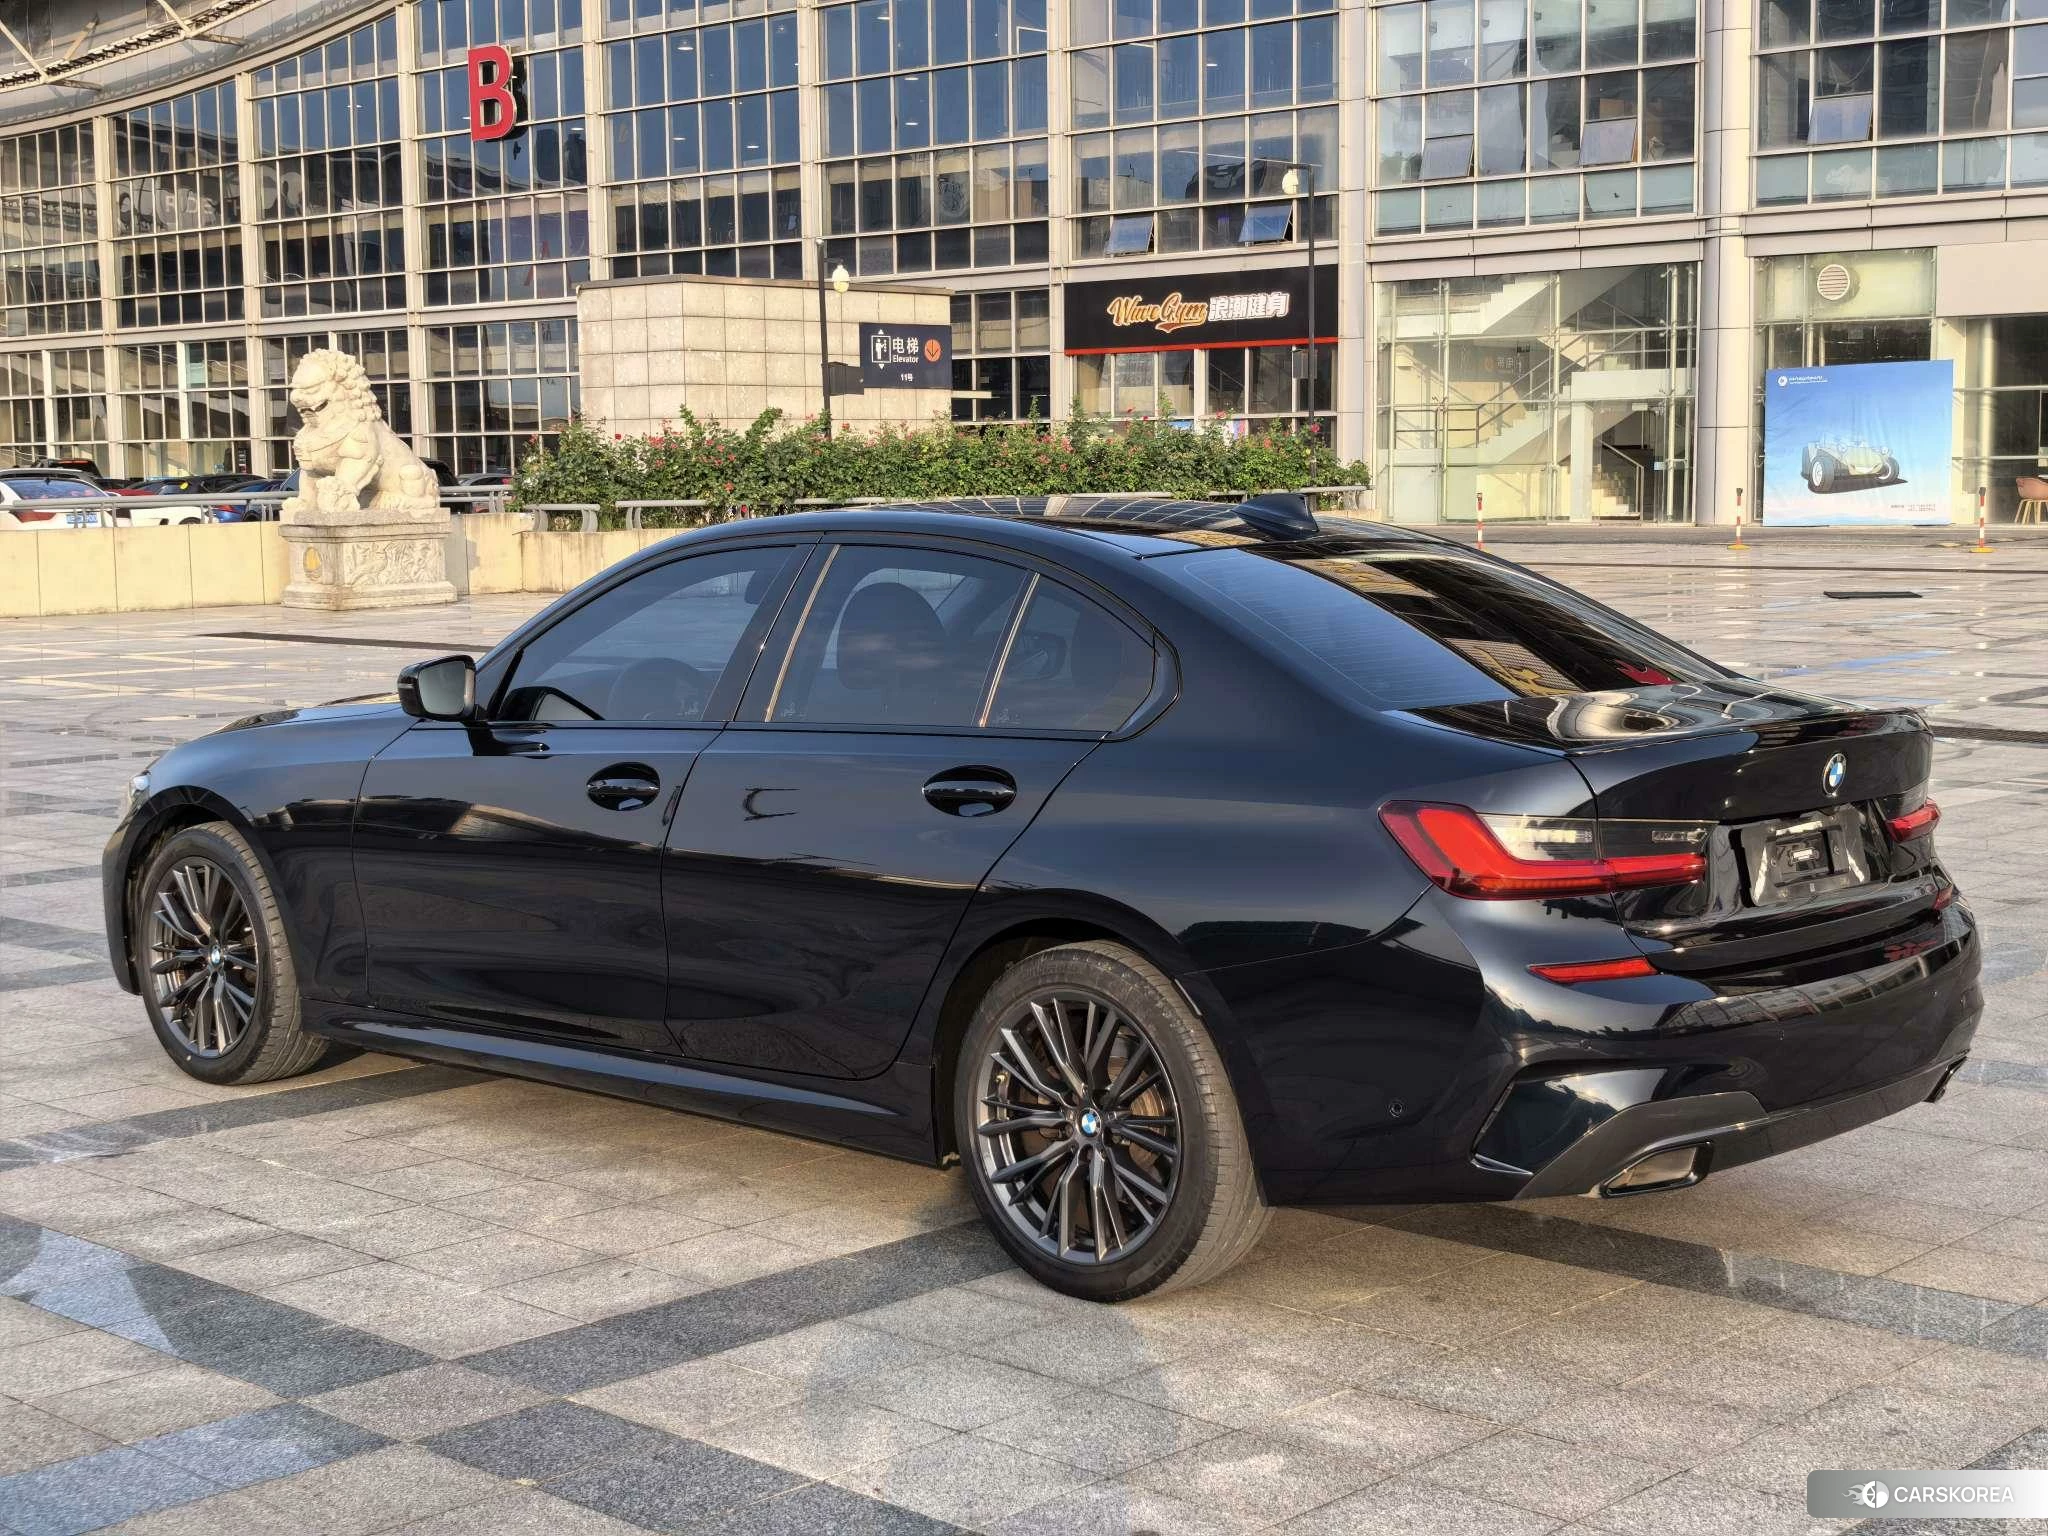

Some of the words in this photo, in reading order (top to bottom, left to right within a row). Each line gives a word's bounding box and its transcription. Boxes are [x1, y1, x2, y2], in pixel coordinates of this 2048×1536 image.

[467, 45, 516, 141] B
[1107, 295, 1160, 326] Wave
[1159, 292, 1208, 328] Gym
[1208, 291, 1290, 322] 浪潮健身
[892, 336, 919, 355] 电梯
[892, 354, 919, 364] Elevator
